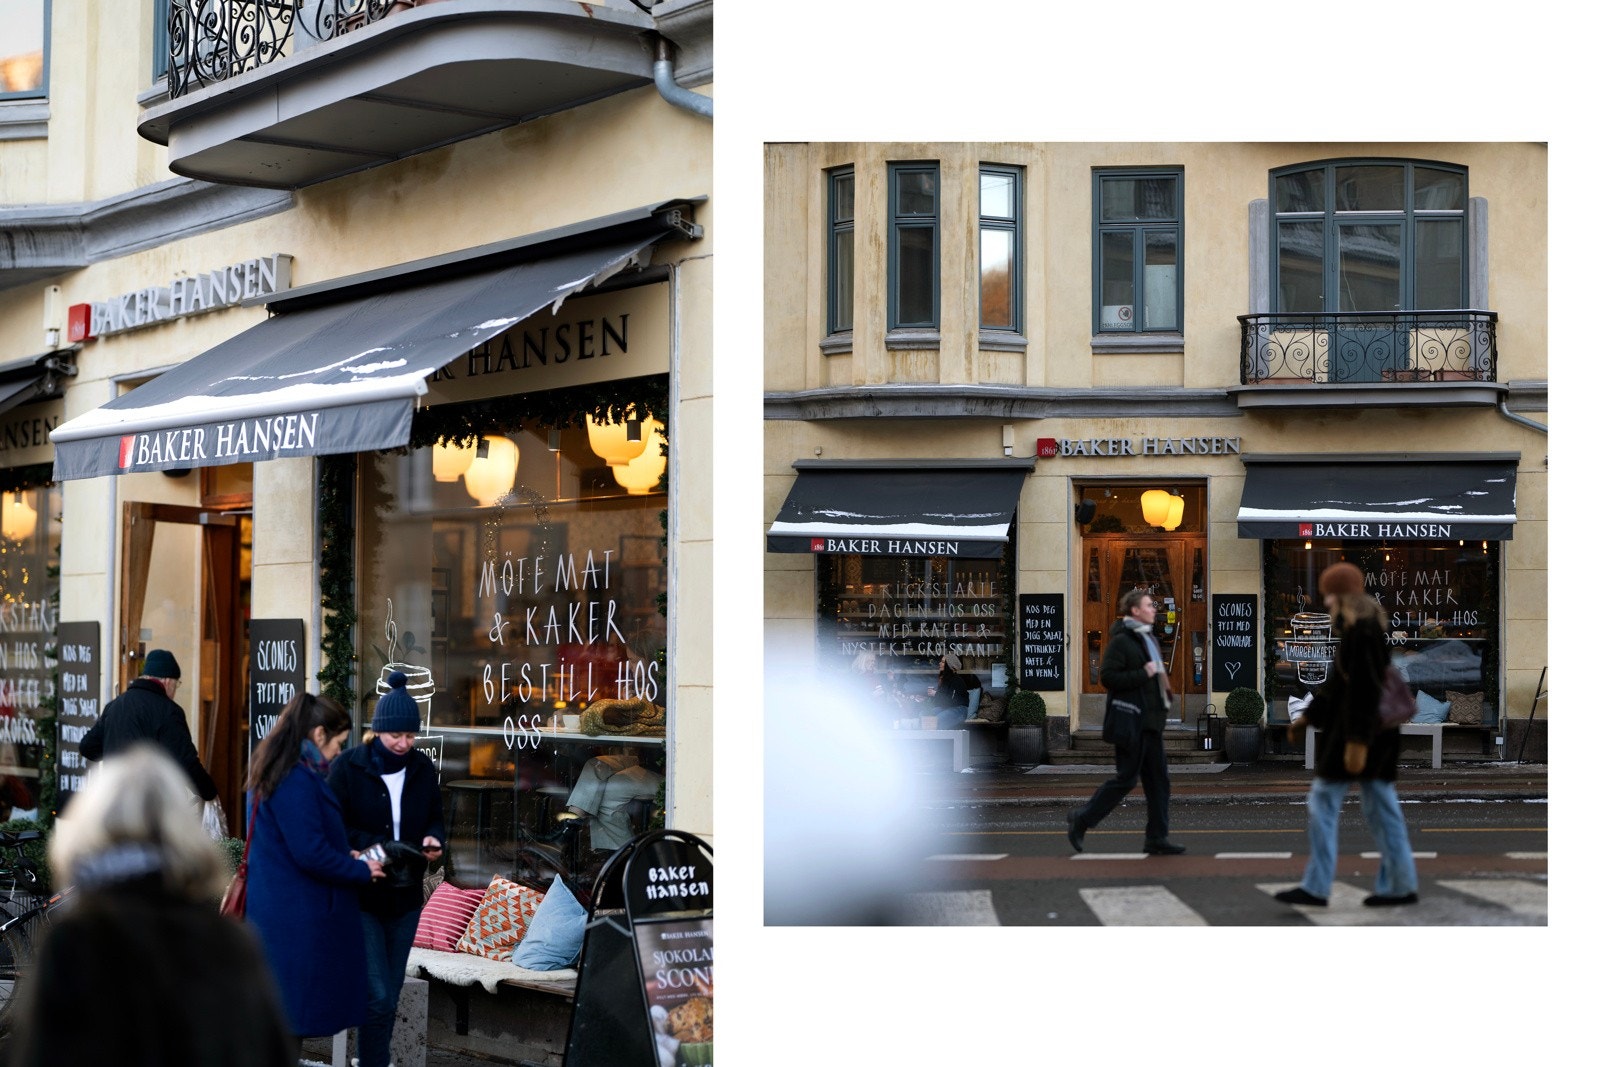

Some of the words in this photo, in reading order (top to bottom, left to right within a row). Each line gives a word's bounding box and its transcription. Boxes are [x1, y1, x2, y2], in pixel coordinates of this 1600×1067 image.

[88, 284, 164, 338] BAKER
[167, 252, 282, 318] HANSEN
[467, 313, 630, 377] HANSEN
[0, 415, 58, 450] NSEN
[136, 429, 206, 465] BAKER
[215, 413, 319, 457] HANSEN
[1041, 447, 1056, 456] 1861
[1060, 440, 1136, 457] BAKER
[1142, 437, 1241, 455] HANSEN
[1315, 523, 1372, 537] BAKER
[1378, 523, 1452, 538] HANSEN
[827, 539, 882, 553] BAKER
[888, 540, 960, 555] HANSEN
[555, 549, 614, 592] MAT
[1414, 569, 1450, 586] MAT
[1396, 588, 1459, 606] KAKER
[868, 603, 928, 619] DAGEN
[938, 603, 964, 618] HOS
[973, 603, 995, 617] OSS
[1026, 605, 1040, 614] KOS
[1043, 605, 1056, 615] DEG
[1219, 602, 1252, 617] SCONES
[1391, 609, 1442, 628] STILL
[1453, 610, 1478, 626] HOS
[489, 612, 510, 645] &
[526, 599, 626, 645] KAKER
[878, 623, 910, 639] MED
[920, 622, 969, 638] KAFFE
[976, 623, 991, 639] &
[1041, 619, 1051, 629] EN
[1218, 621, 1234, 631] FYLT
[1236, 620, 1251, 631] MED
[842, 642, 907, 656] NYSTEKT
[1217, 634, 1253, 648] SJOKOLADE
[14, 641, 38, 670] HOS
[257, 640, 297, 673] SCONES
[615, 659, 658, 703] HOS
[1025, 668, 1034, 678] EN
[1036, 668, 1053, 678] VENN
[256, 682, 277, 705] FYLT
[653, 947, 713, 968] SJOKOLA
[656, 966, 713, 990] SCON
